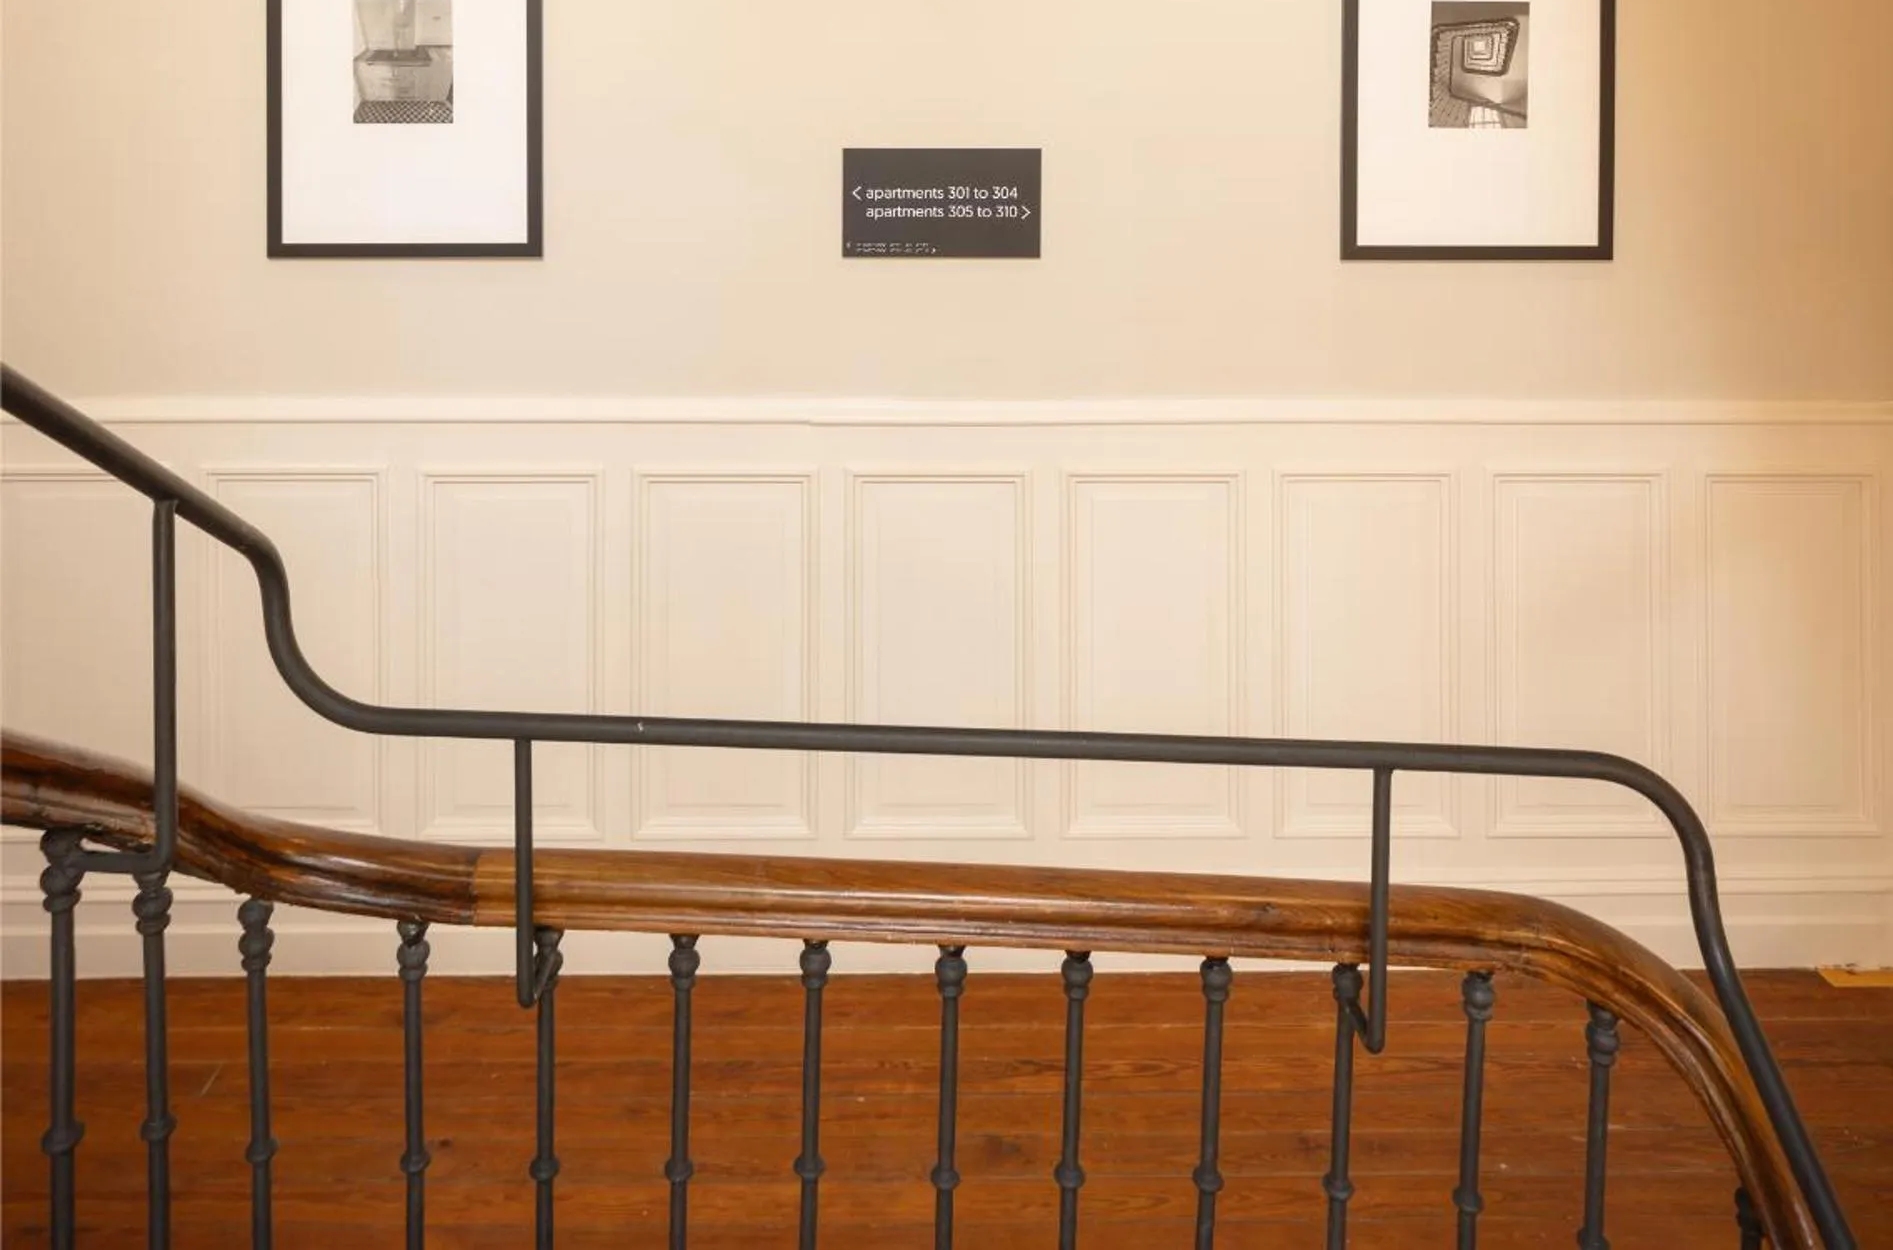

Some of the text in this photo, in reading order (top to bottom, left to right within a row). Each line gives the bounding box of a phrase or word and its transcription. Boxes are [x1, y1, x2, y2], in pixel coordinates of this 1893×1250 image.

[865, 186, 1018, 202] apartments 301 to 304
[865, 204, 1019, 221] apartments 305 to 310
